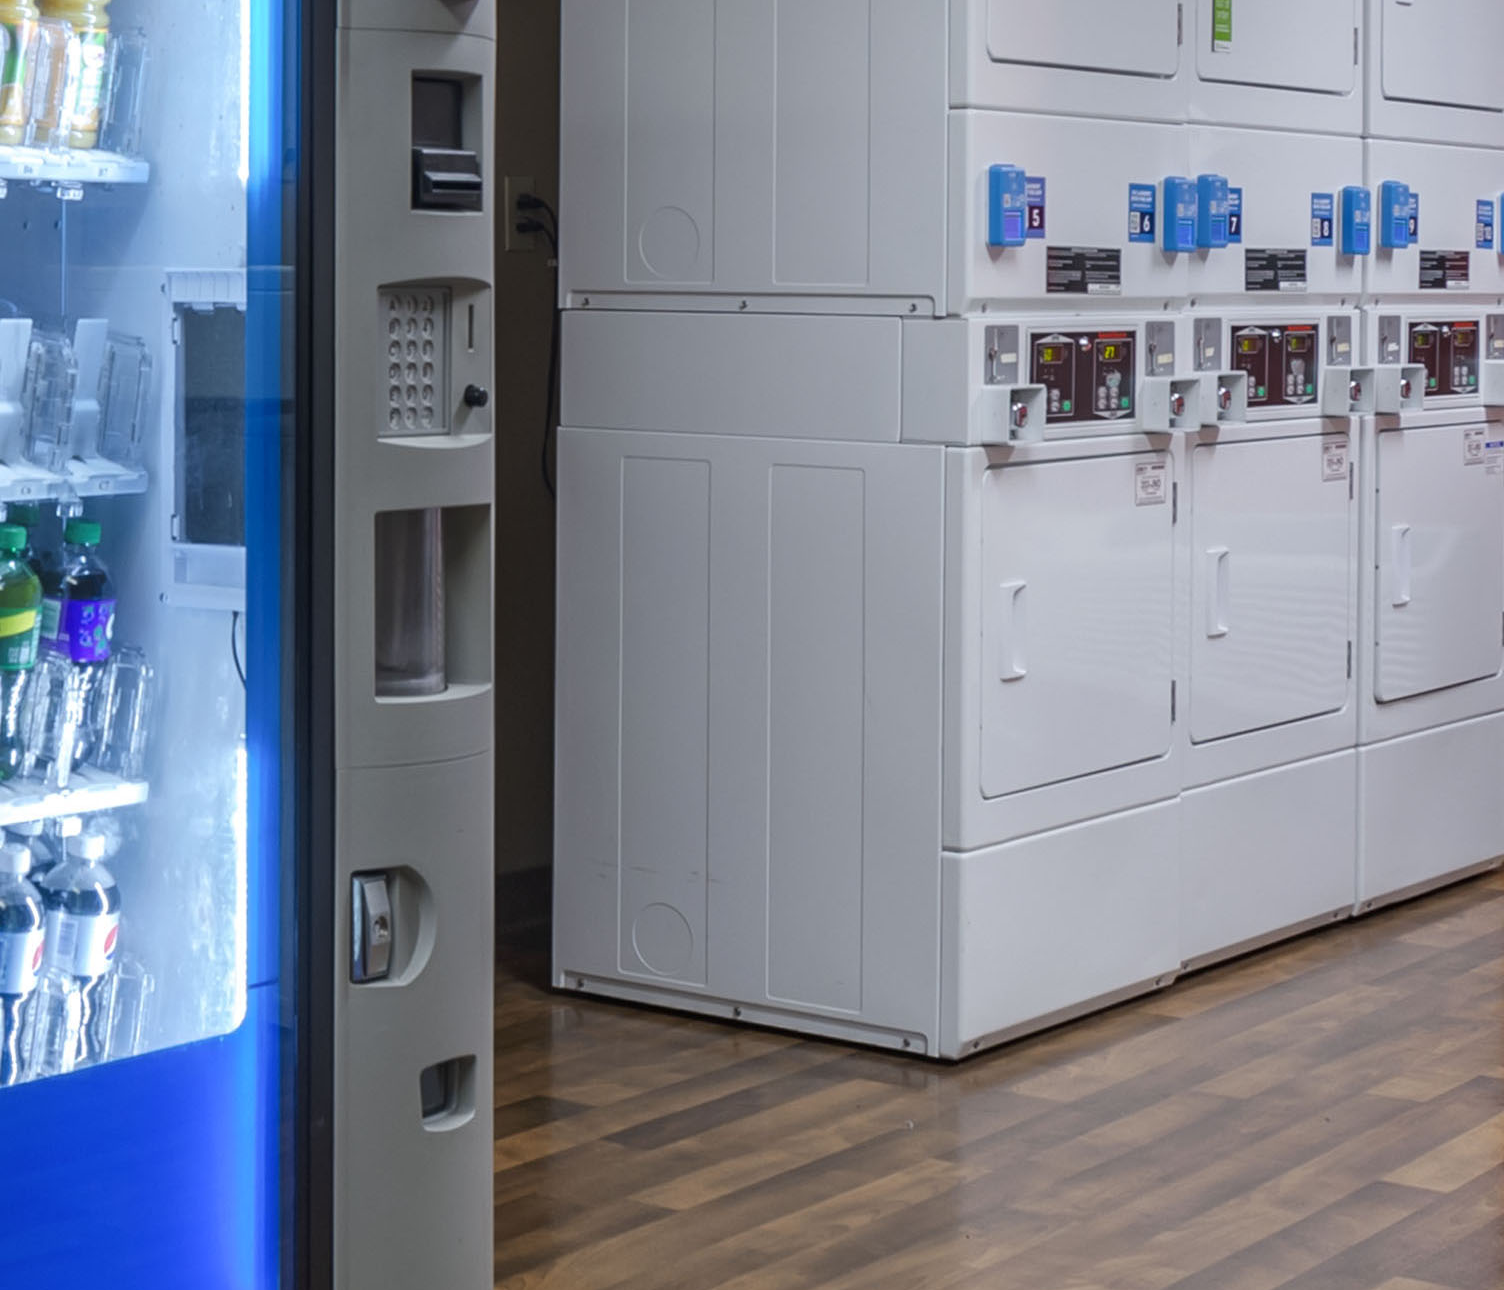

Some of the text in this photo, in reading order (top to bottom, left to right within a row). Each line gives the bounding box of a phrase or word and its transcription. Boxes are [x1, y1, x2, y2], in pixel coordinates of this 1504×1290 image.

[1031, 208, 1041, 228] 5
[1143, 213, 1151, 233] 6
[1230, 215, 1238, 233] 7
[1323, 218, 1330, 237] 8
